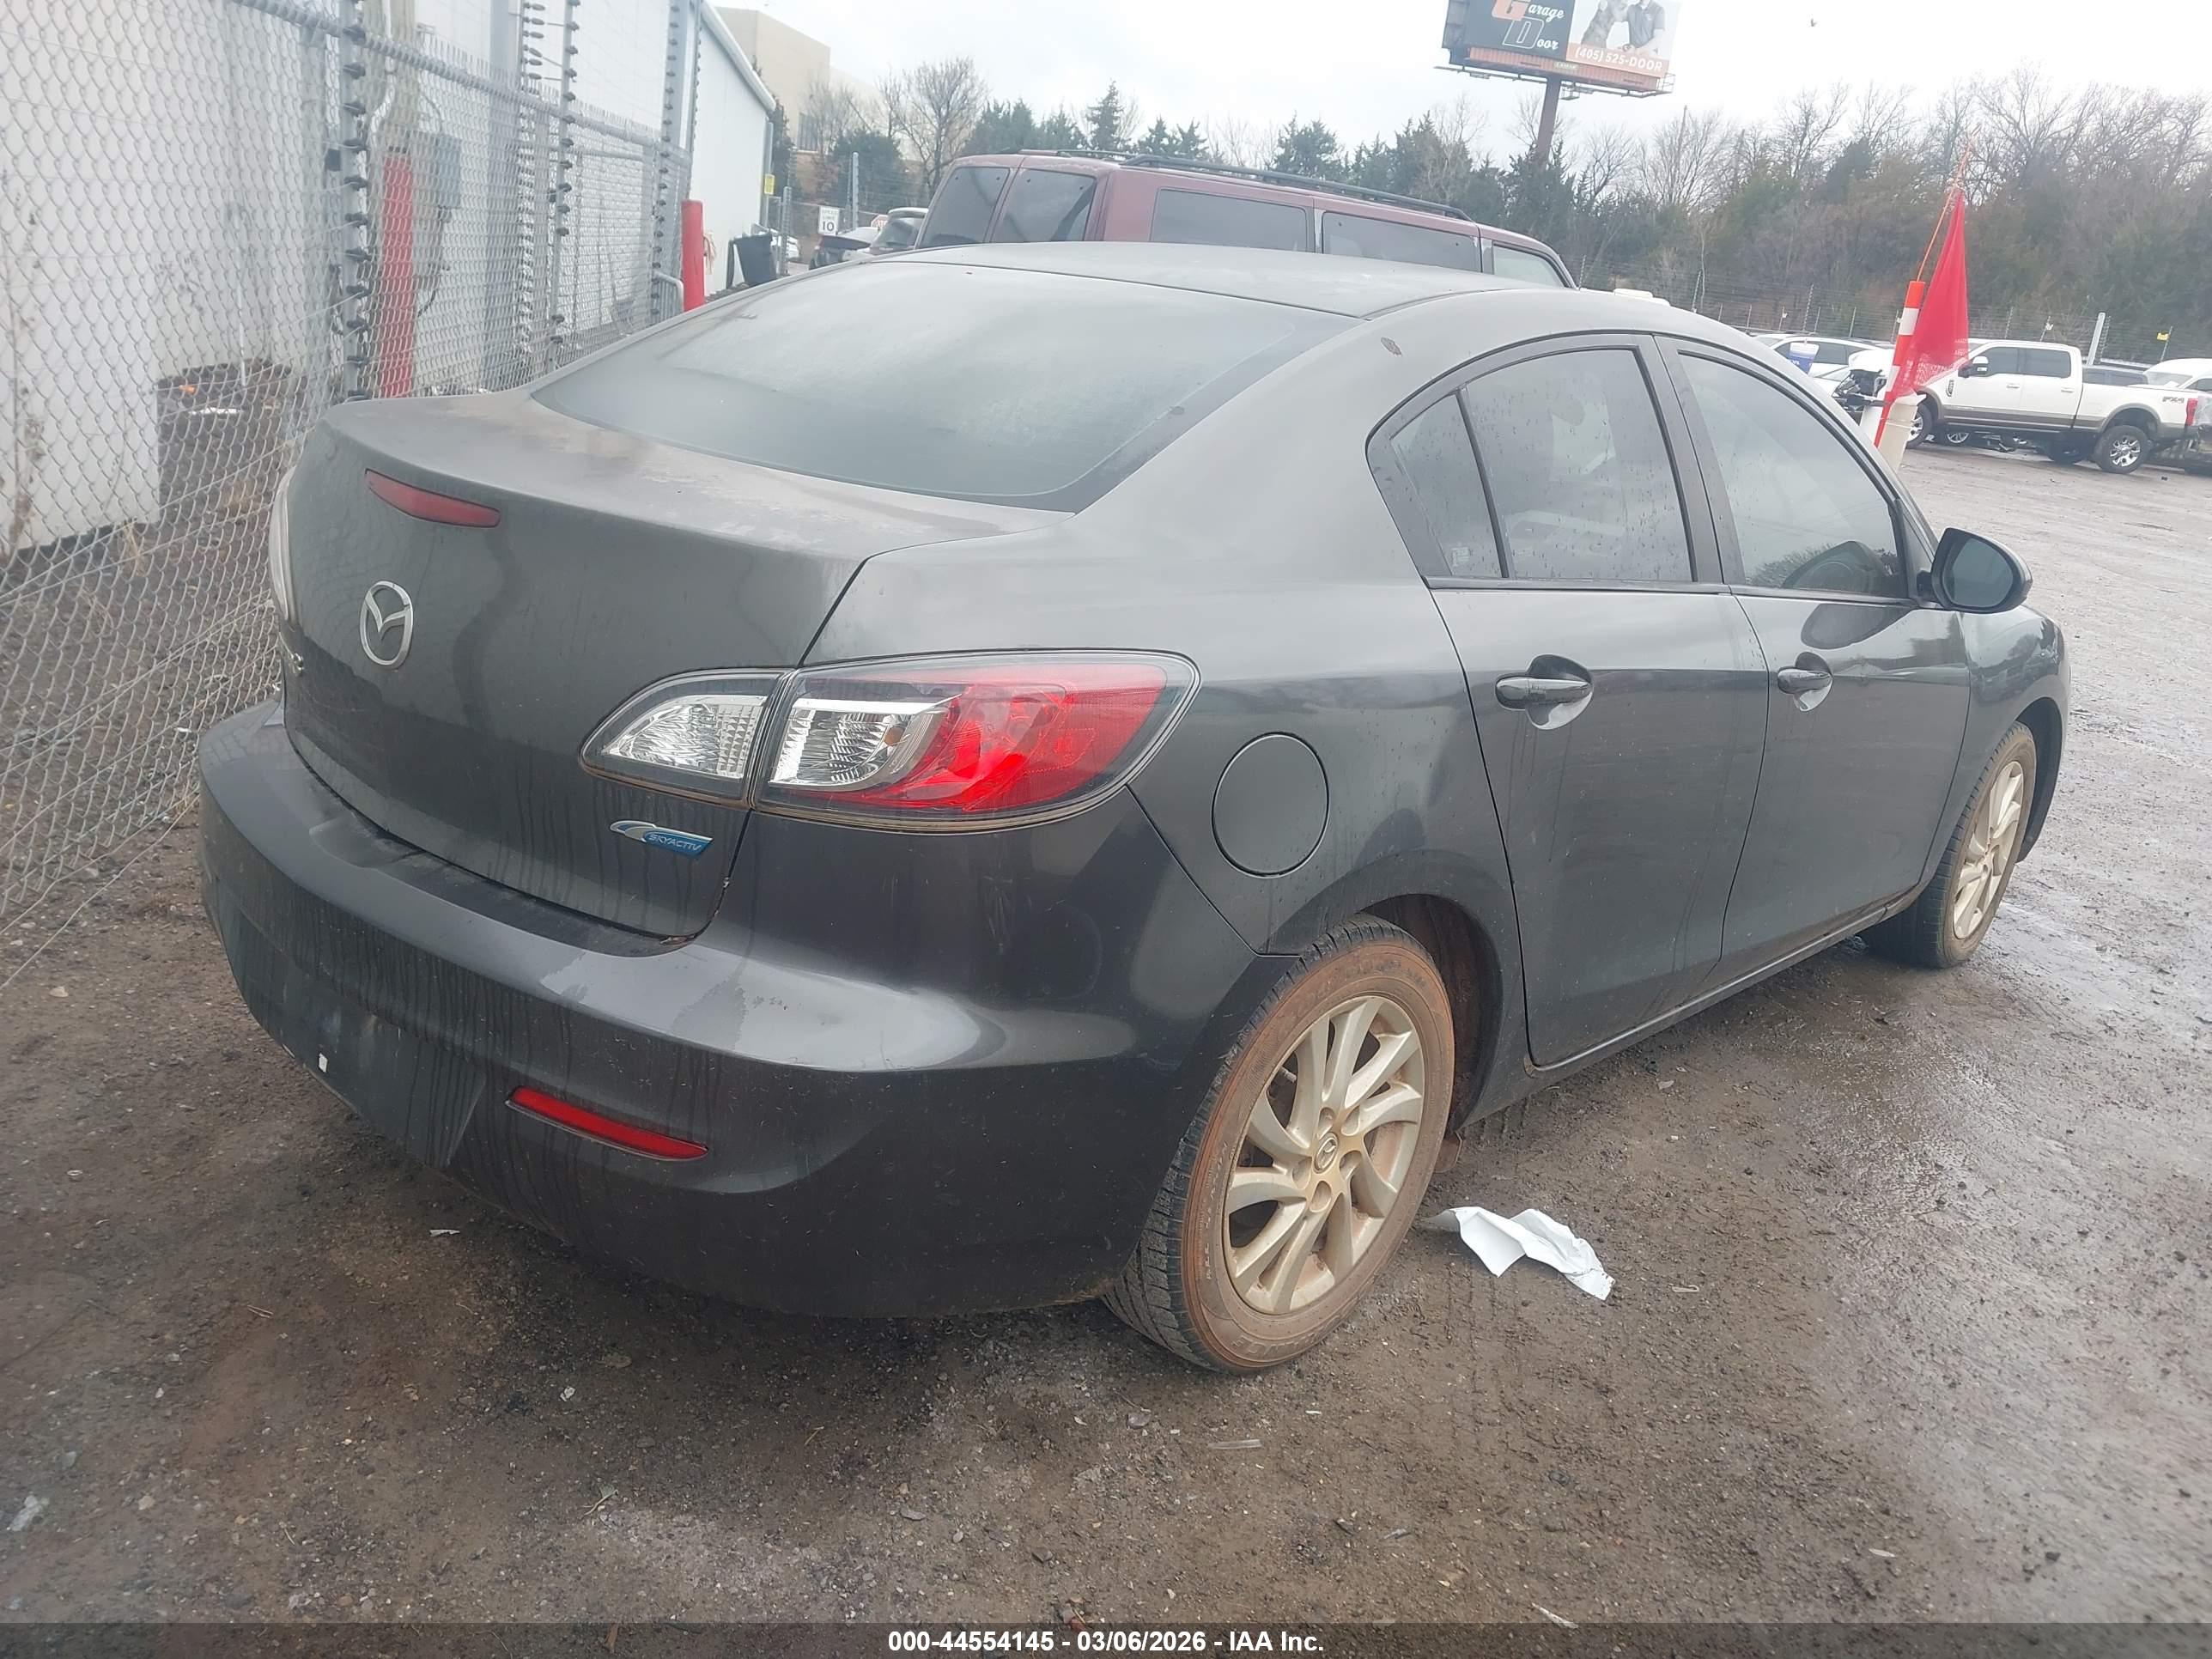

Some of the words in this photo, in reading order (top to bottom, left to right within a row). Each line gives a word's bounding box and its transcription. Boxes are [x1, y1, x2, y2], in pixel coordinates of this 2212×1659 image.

[1502, 16, 1559, 49] Door
[1575, 47, 1604, 62] (405)
[1605, 52, 1662, 71] 525-DOOR
[823, 221, 835, 232] 10
[648, 834, 702, 851] SKYACTIV
